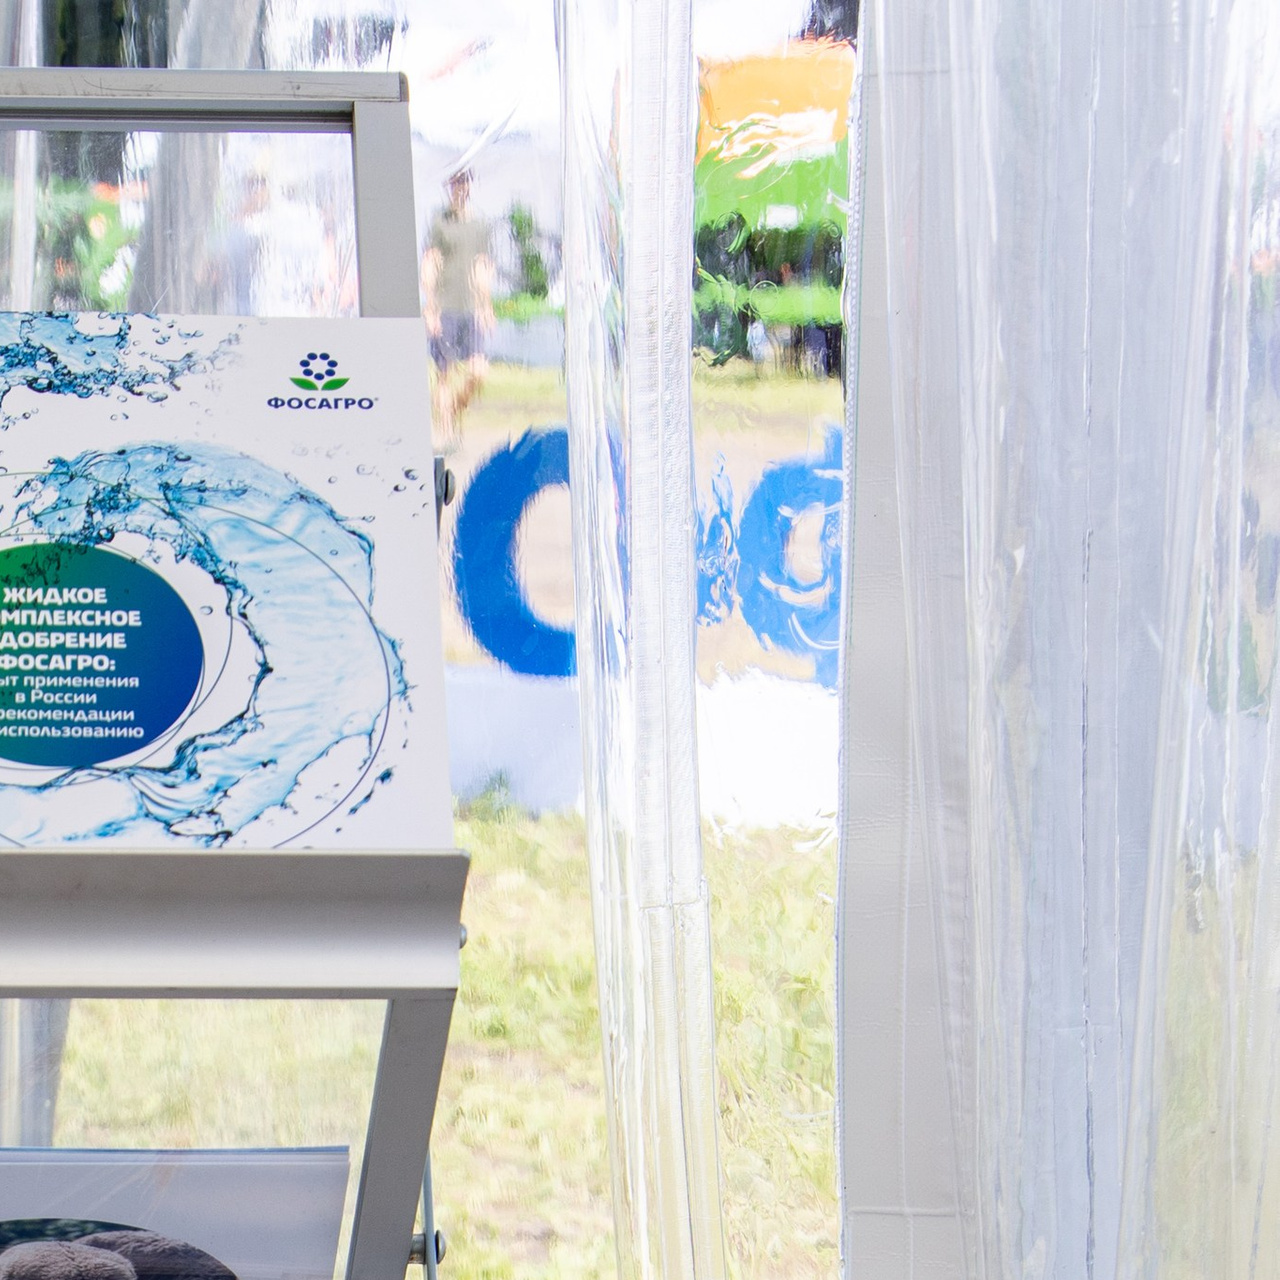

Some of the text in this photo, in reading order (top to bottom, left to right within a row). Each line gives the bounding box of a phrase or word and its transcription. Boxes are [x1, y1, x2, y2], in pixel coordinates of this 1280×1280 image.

[267, 397, 374, 409] ФОСАГРО
[3, 587, 107, 606] ЖИДКОЕ
[23, 676, 139, 689] применения
[15, 689, 97, 703] в России
